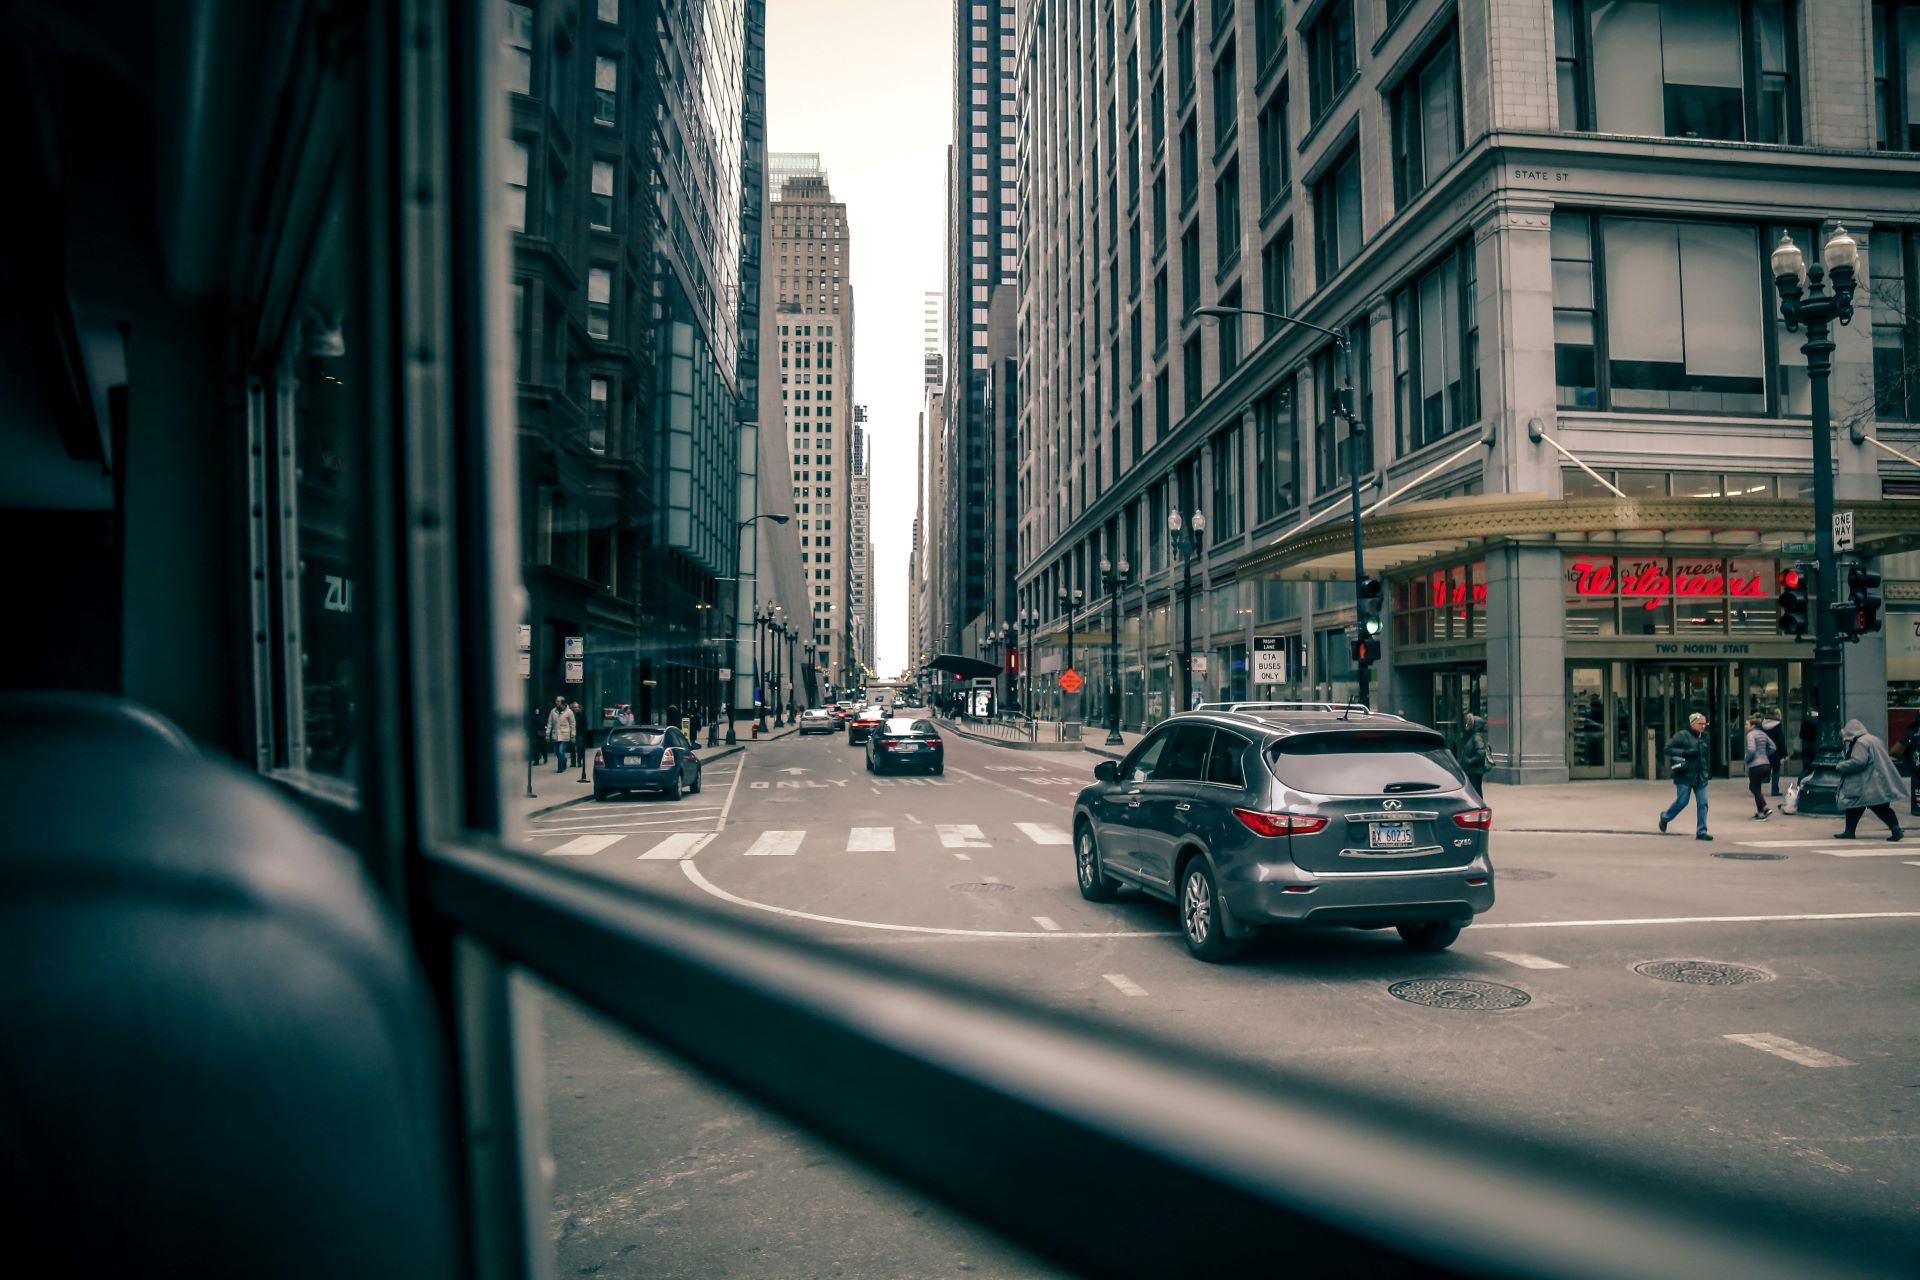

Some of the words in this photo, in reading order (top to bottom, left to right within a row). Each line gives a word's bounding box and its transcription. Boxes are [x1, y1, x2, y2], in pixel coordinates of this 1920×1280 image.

[1515, 170, 1548, 181] STATE
[1556, 173, 1569, 182] ST
[1834, 514, 1851, 525] ONE
[1834, 525, 1851, 537] WAY
[1572, 562, 1770, 611] Walgreens
[1656, 644, 1678, 654] TWO
[1683, 644, 1718, 654] NORTH
[1722, 644, 1749, 654] STATE
[750, 779, 849, 789] ONLY
[1386, 829, 1412, 842] 60235
[1453, 838, 1472, 848] QX60
